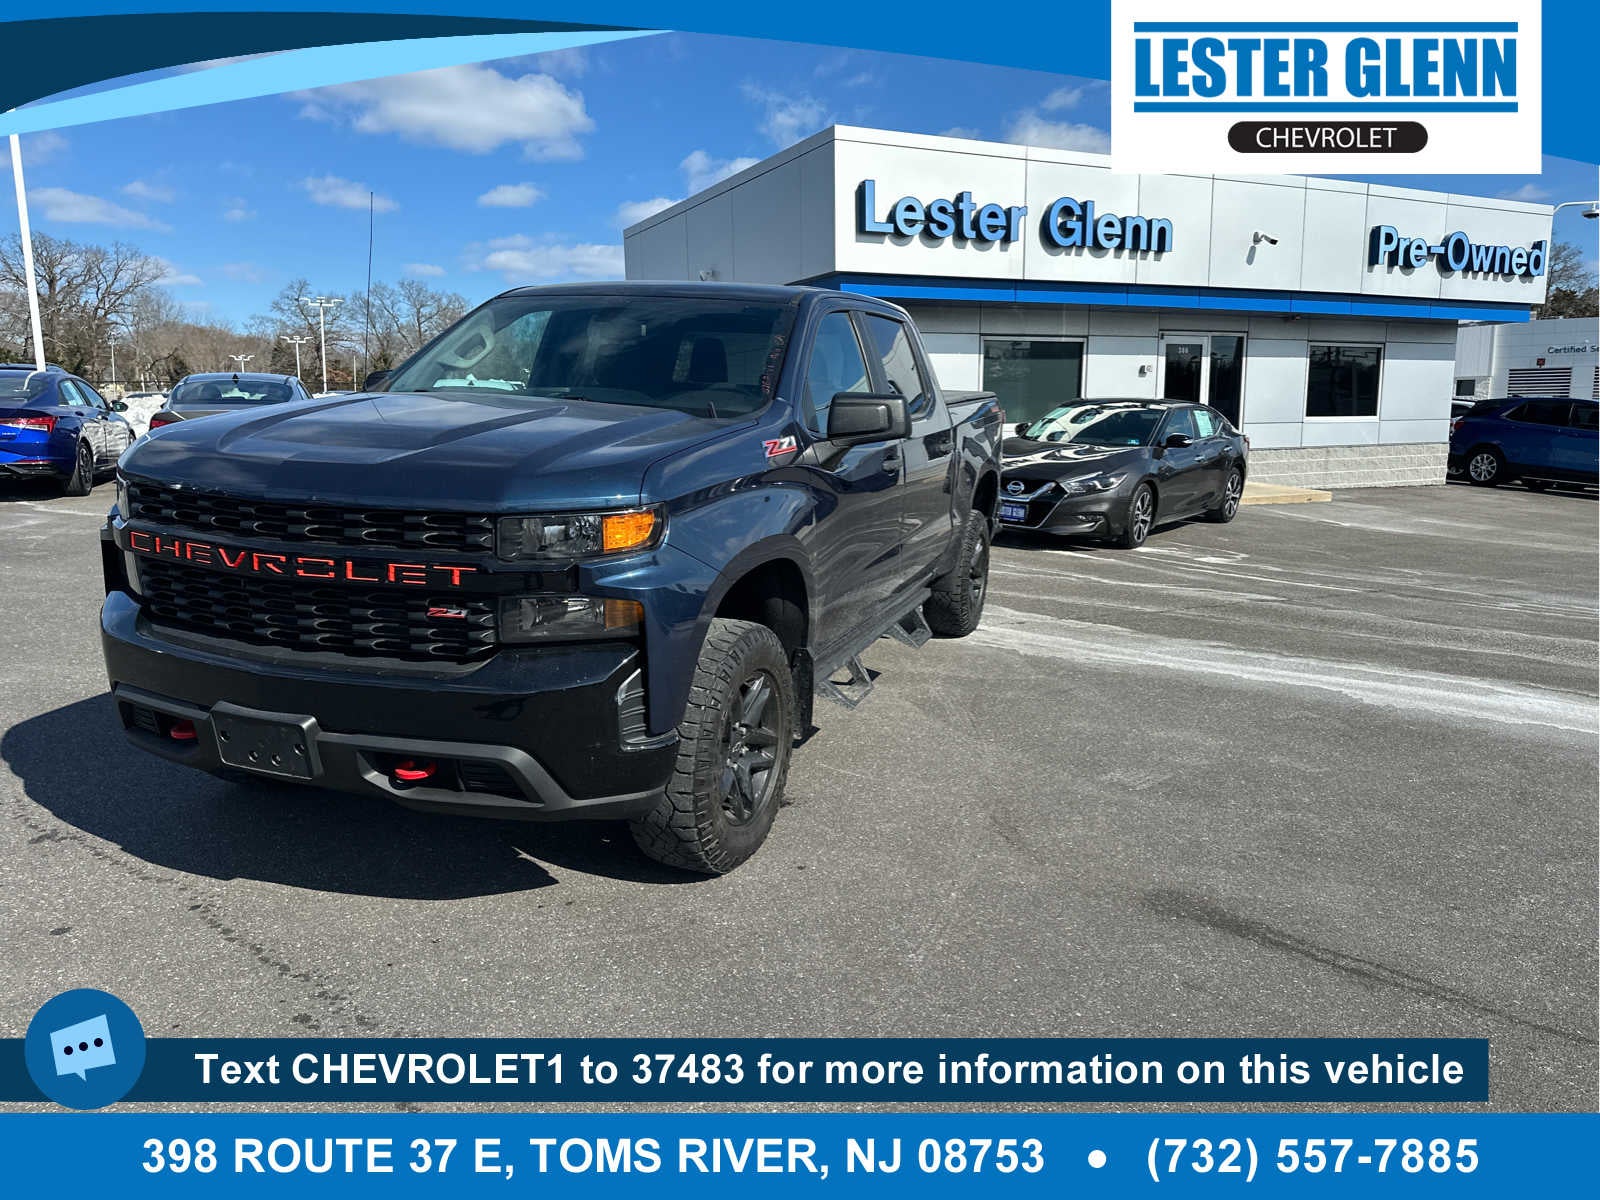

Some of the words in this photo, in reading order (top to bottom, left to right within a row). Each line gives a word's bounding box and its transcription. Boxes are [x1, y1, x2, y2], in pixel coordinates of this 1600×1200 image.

[856, 179, 1027, 242] Lester
[1043, 196, 1173, 252] Glenn
[1369, 225, 1548, 277] Pre-Owned
[1547, 345, 1587, 354] Certified
[130, 532, 475, 586] CHEVROLET
